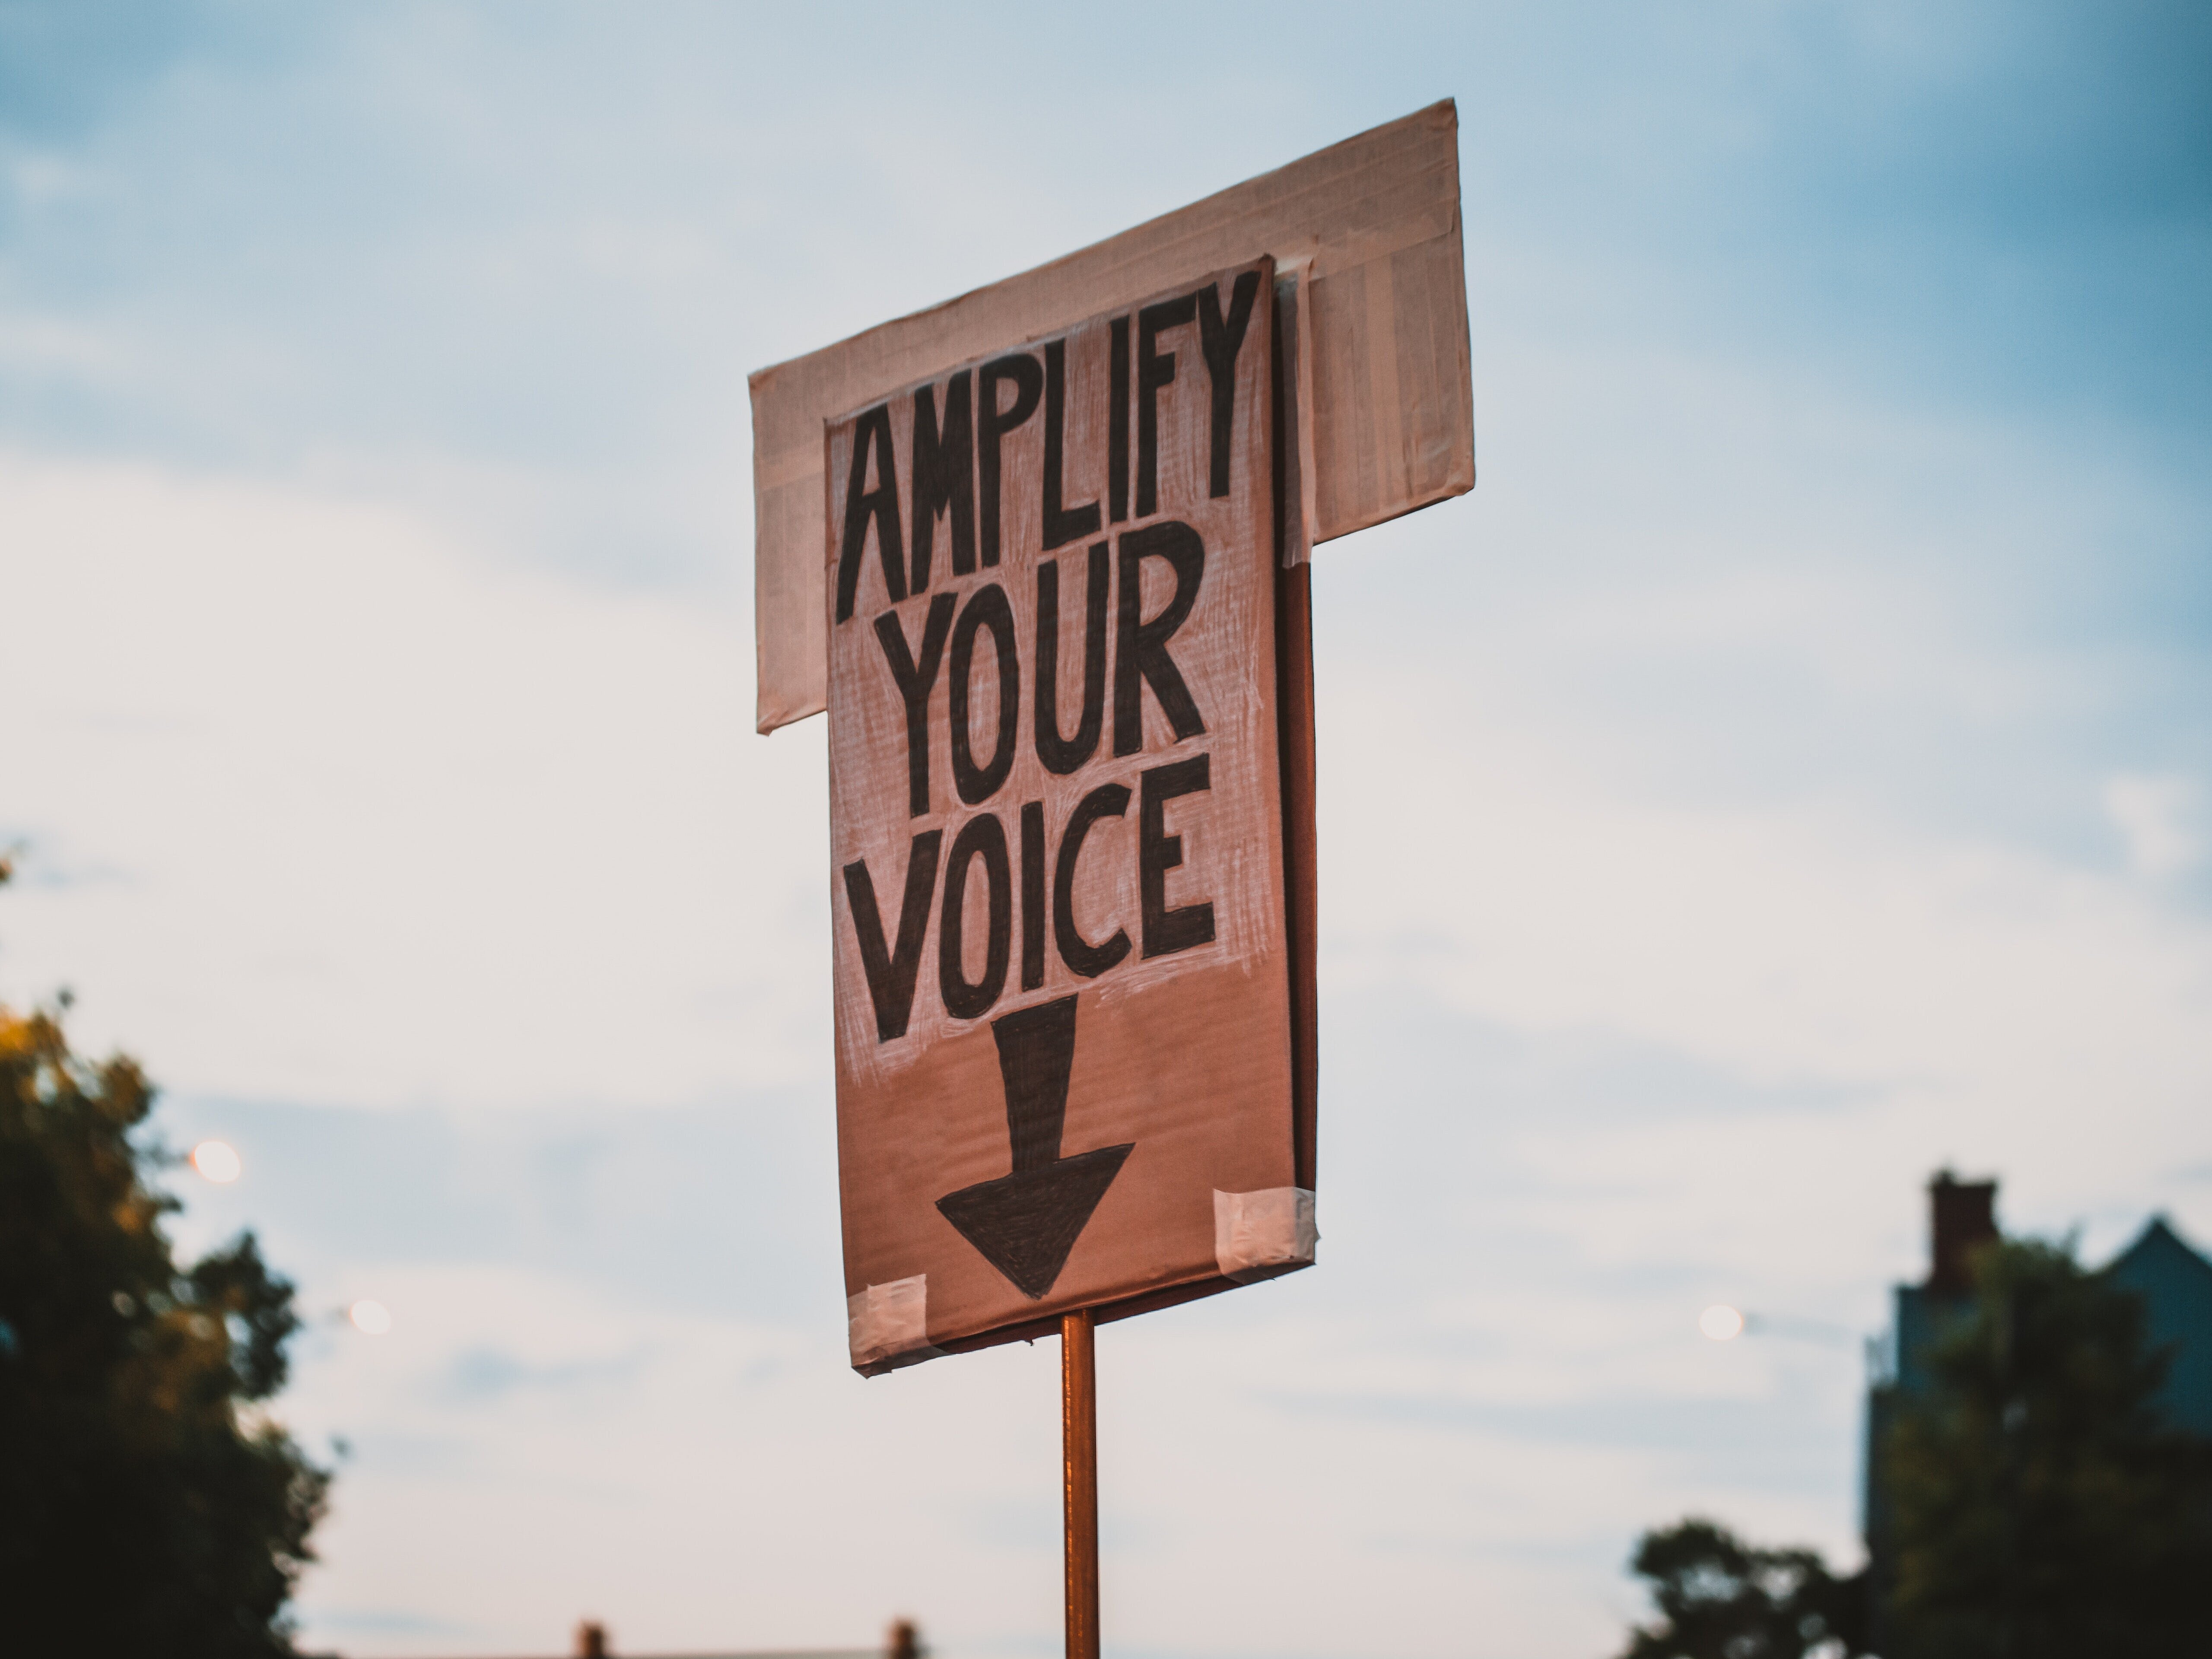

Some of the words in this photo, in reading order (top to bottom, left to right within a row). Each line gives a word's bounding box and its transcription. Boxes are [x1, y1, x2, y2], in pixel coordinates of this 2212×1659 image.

[837, 270, 1260, 625] AMPLIFY
[874, 521, 1205, 818] YOUR
[843, 753, 1216, 1043] VOICE
